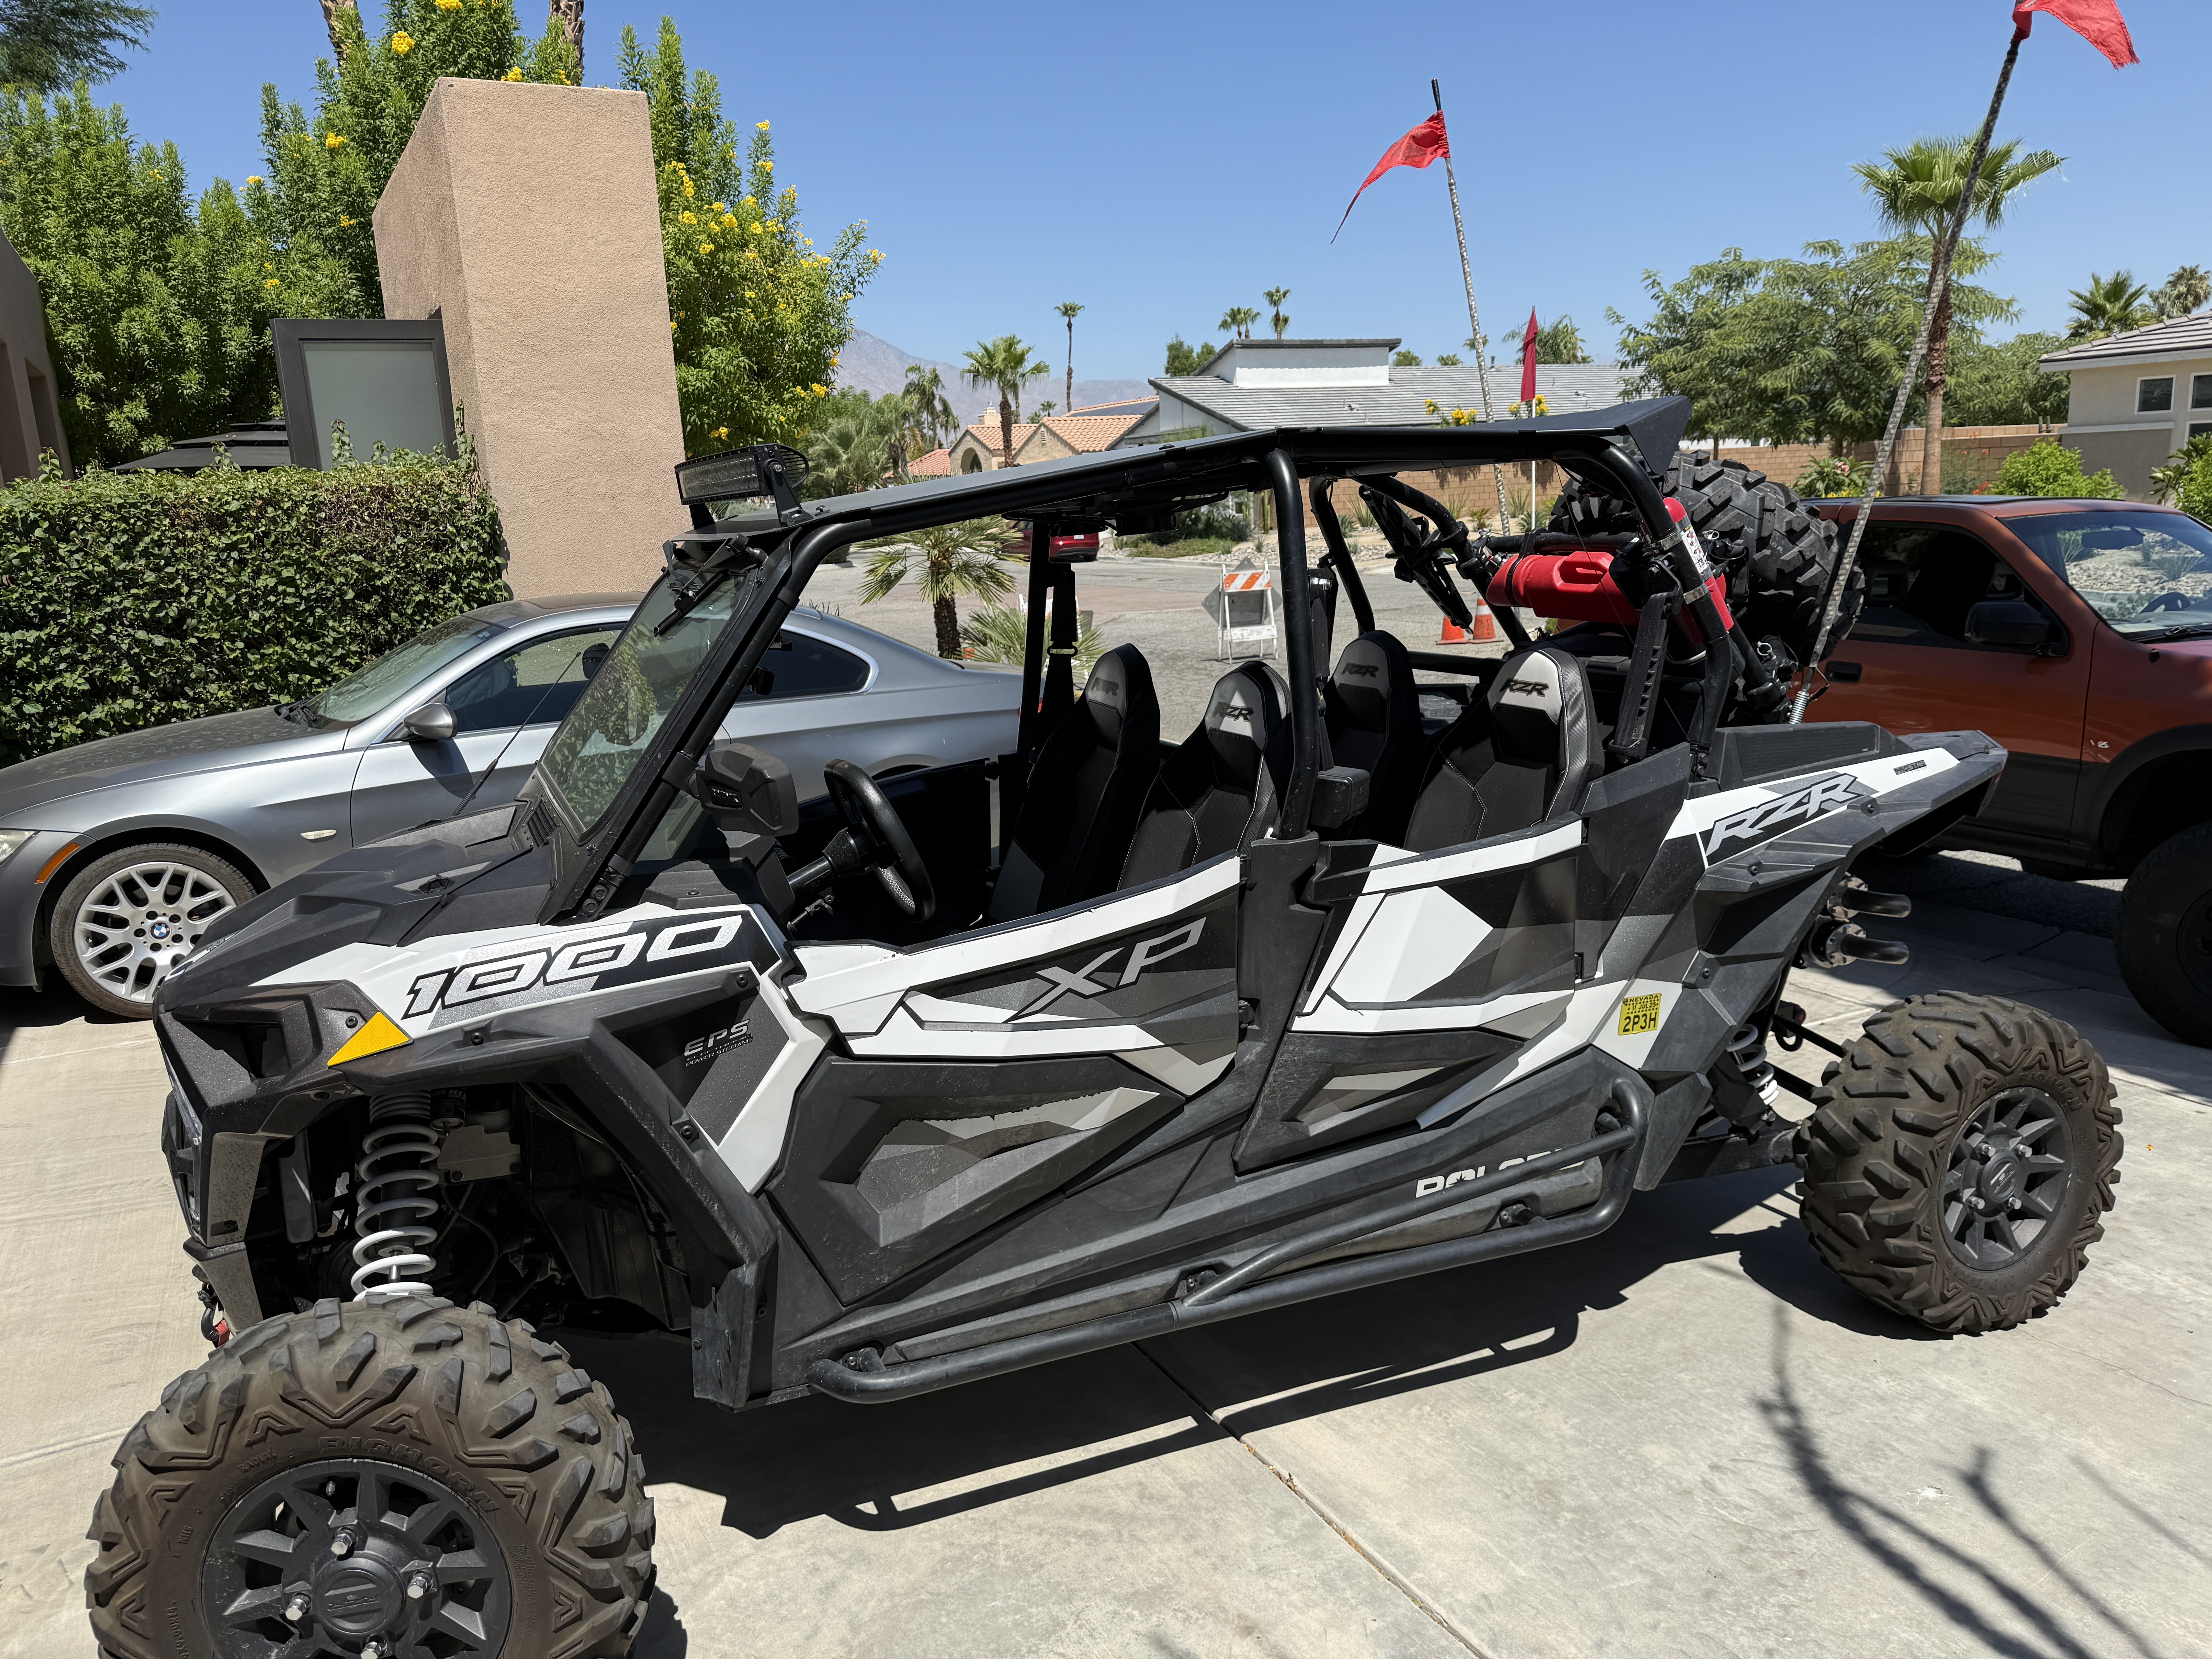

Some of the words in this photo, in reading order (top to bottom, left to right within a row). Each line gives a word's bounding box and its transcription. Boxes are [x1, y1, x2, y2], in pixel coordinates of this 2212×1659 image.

[1341, 662, 1379, 677] RZR
[1499, 678, 1549, 697] RZR
[1212, 701, 1254, 722] RZR
[2089, 739, 2109, 748] V6
[1894, 760, 1927, 775] PROSTAR
[1705, 773, 1858, 856] RZR
[402, 915, 742, 1020] 1000
[1017, 916, 1207, 1017] XP
[1629, 994, 1659, 1003] NEVADA
[1622, 1011, 1657, 1033] 2P3H
[684, 1019, 750, 1056] EPS
[685, 1053, 714, 1067] POWER
[716, 1037, 753, 1055] STEERING
[237, 1445, 277, 1473] RADIAL
[319, 1436, 499, 1513] BIGHORN
[178, 1525, 193, 1544] NHS
